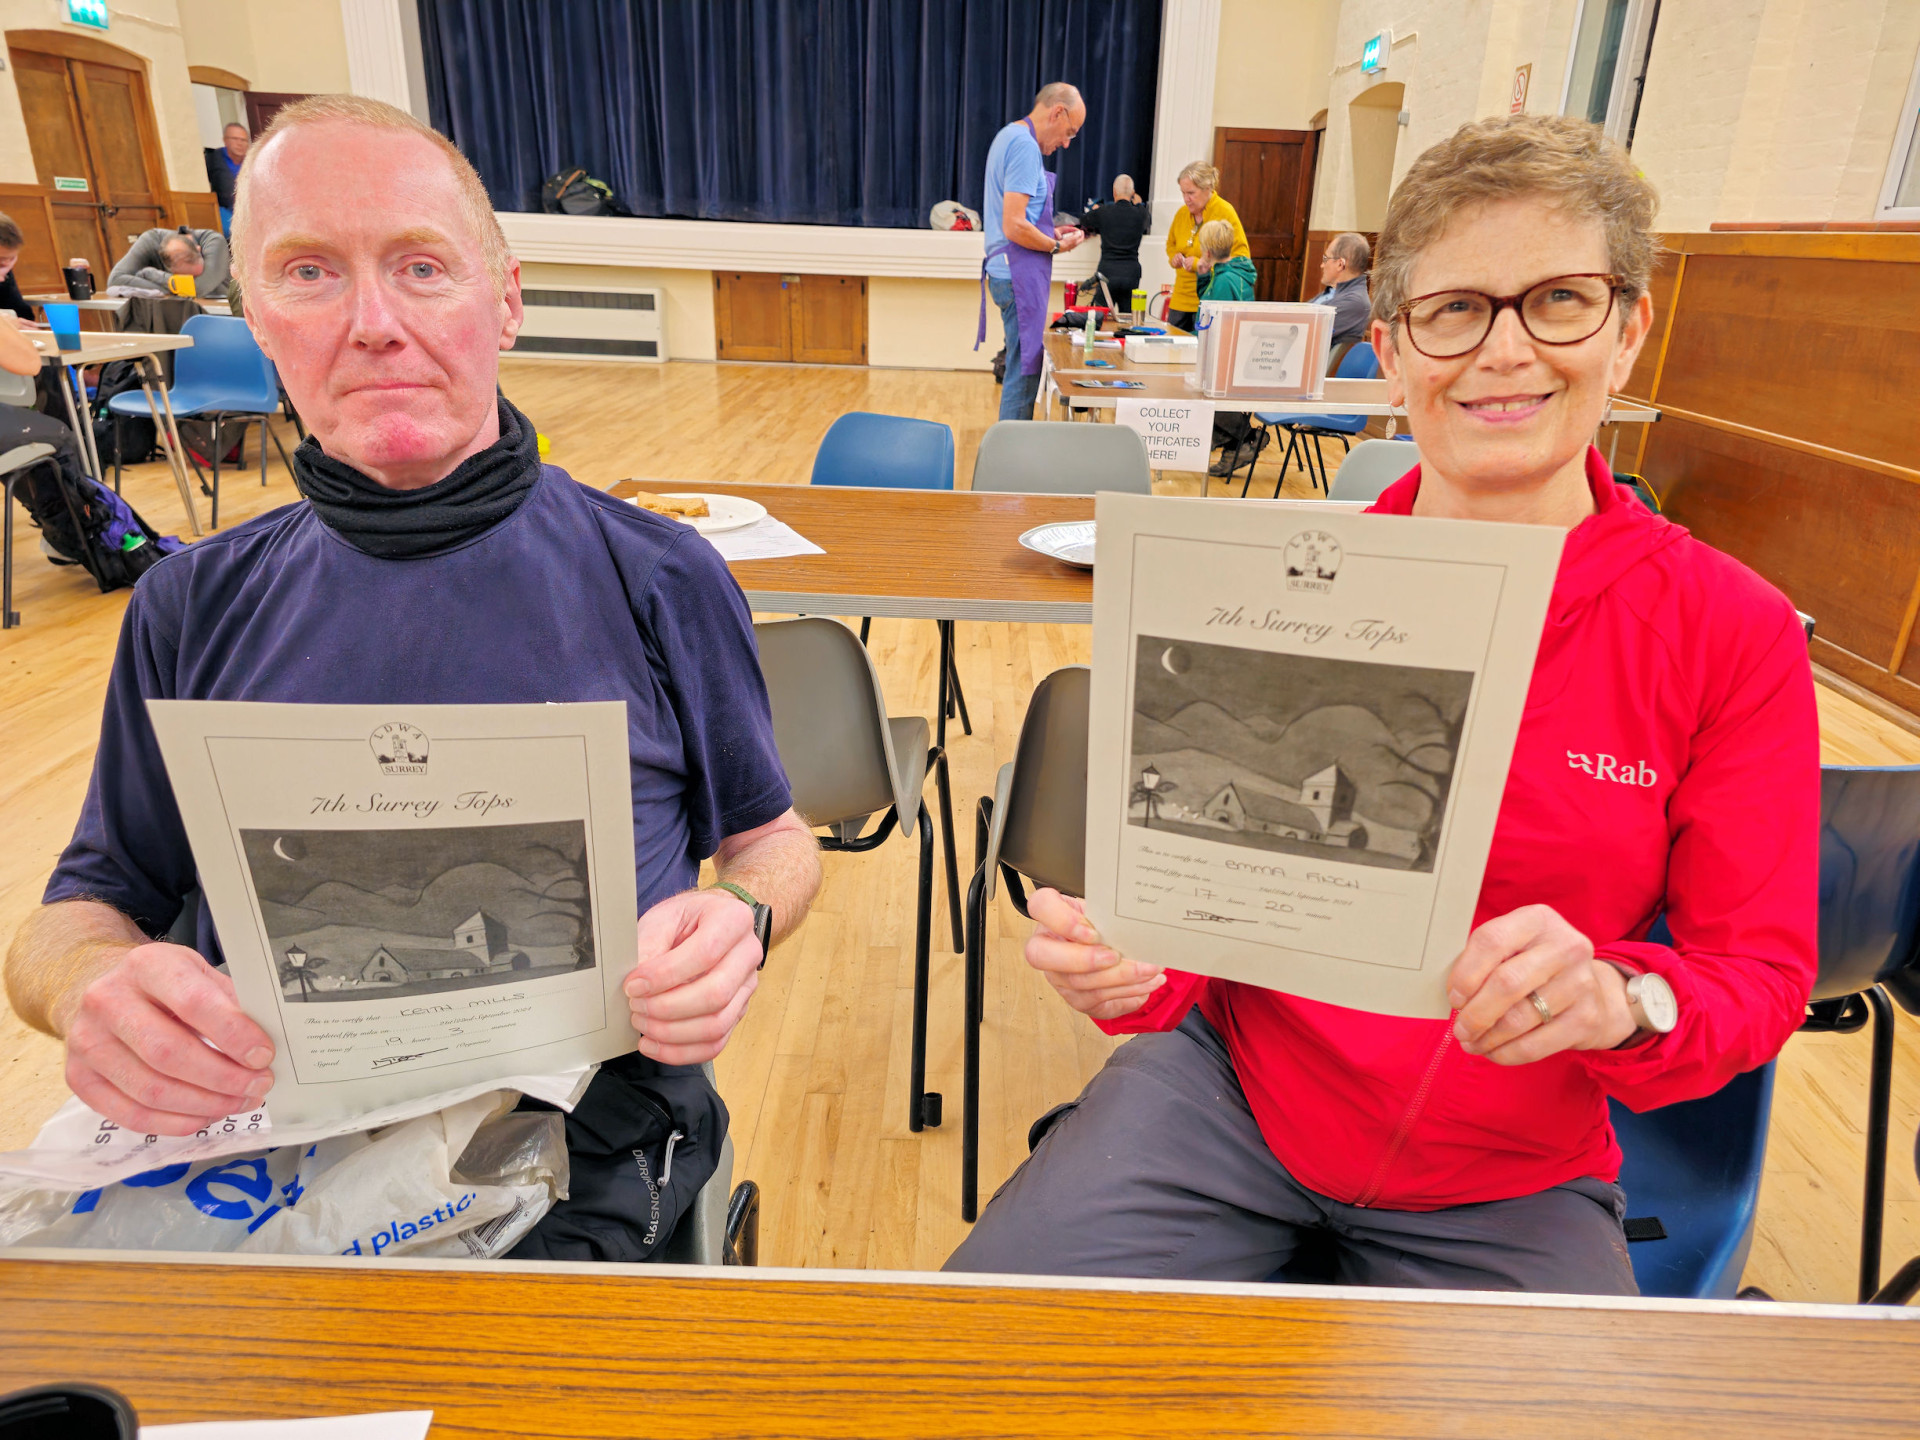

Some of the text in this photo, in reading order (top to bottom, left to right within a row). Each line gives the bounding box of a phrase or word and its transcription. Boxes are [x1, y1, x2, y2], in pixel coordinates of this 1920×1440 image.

[1140, 407, 1191, 419] COLLECT
[1149, 422, 1180, 433] YOUR
[1290, 580, 1329, 591] SURREY
[1206, 606, 1409, 651] 7th Surrey Tops
[374, 723, 422, 740] LDWA
[385, 764, 425, 774] SURREY
[1593, 753, 1657, 787] Rab
[310, 791, 515, 819] 7th Surrey Tops
[1225, 859, 1285, 878] EMMA
[1194, 888, 1217, 900] 17
[1265, 900, 1294, 912] 20
[342, 1016, 363, 1024] certify
[468, 993, 525, 1008] MILLS
[307, 1032, 342, 1040] completed
[385, 1037, 403, 1046] 19
